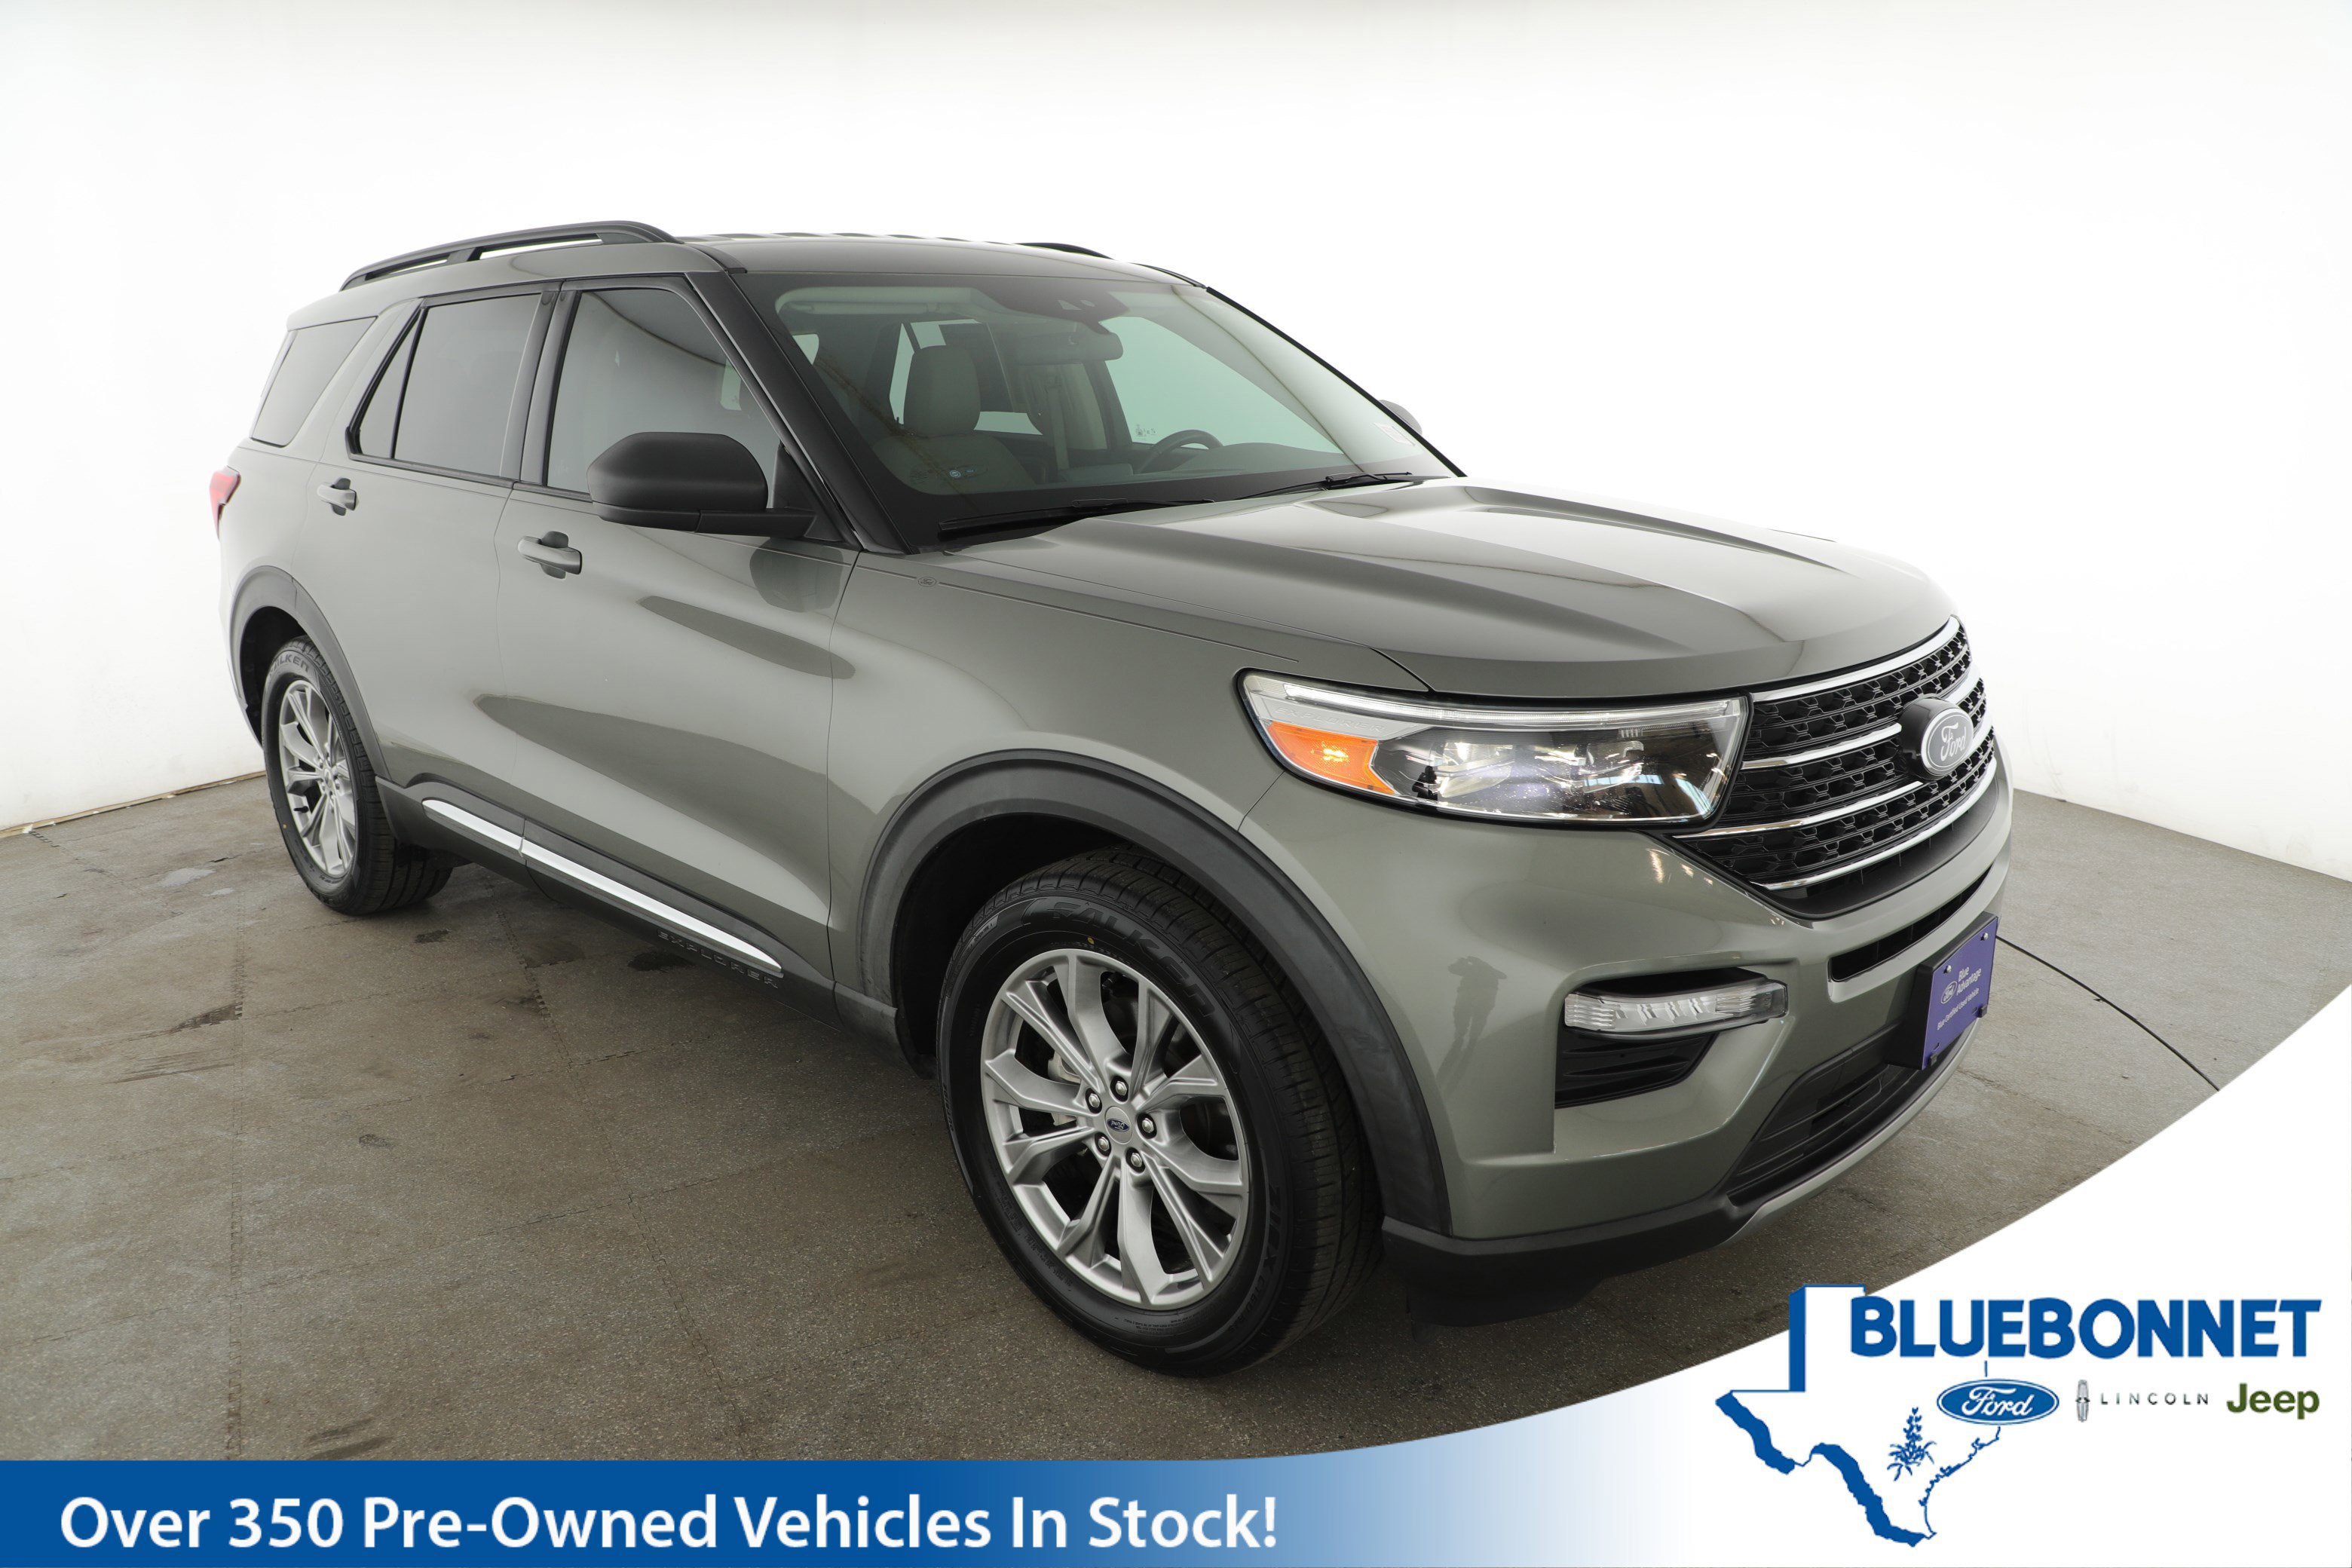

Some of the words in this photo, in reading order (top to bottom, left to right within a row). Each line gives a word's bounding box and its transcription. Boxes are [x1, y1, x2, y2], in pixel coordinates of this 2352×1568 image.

[1274, 707, 1385, 733] EXPLORER
[1940, 722, 1967, 761] Ford
[1956, 968, 1982, 996] Advantage
[1958, 966, 1970, 982] Blue
